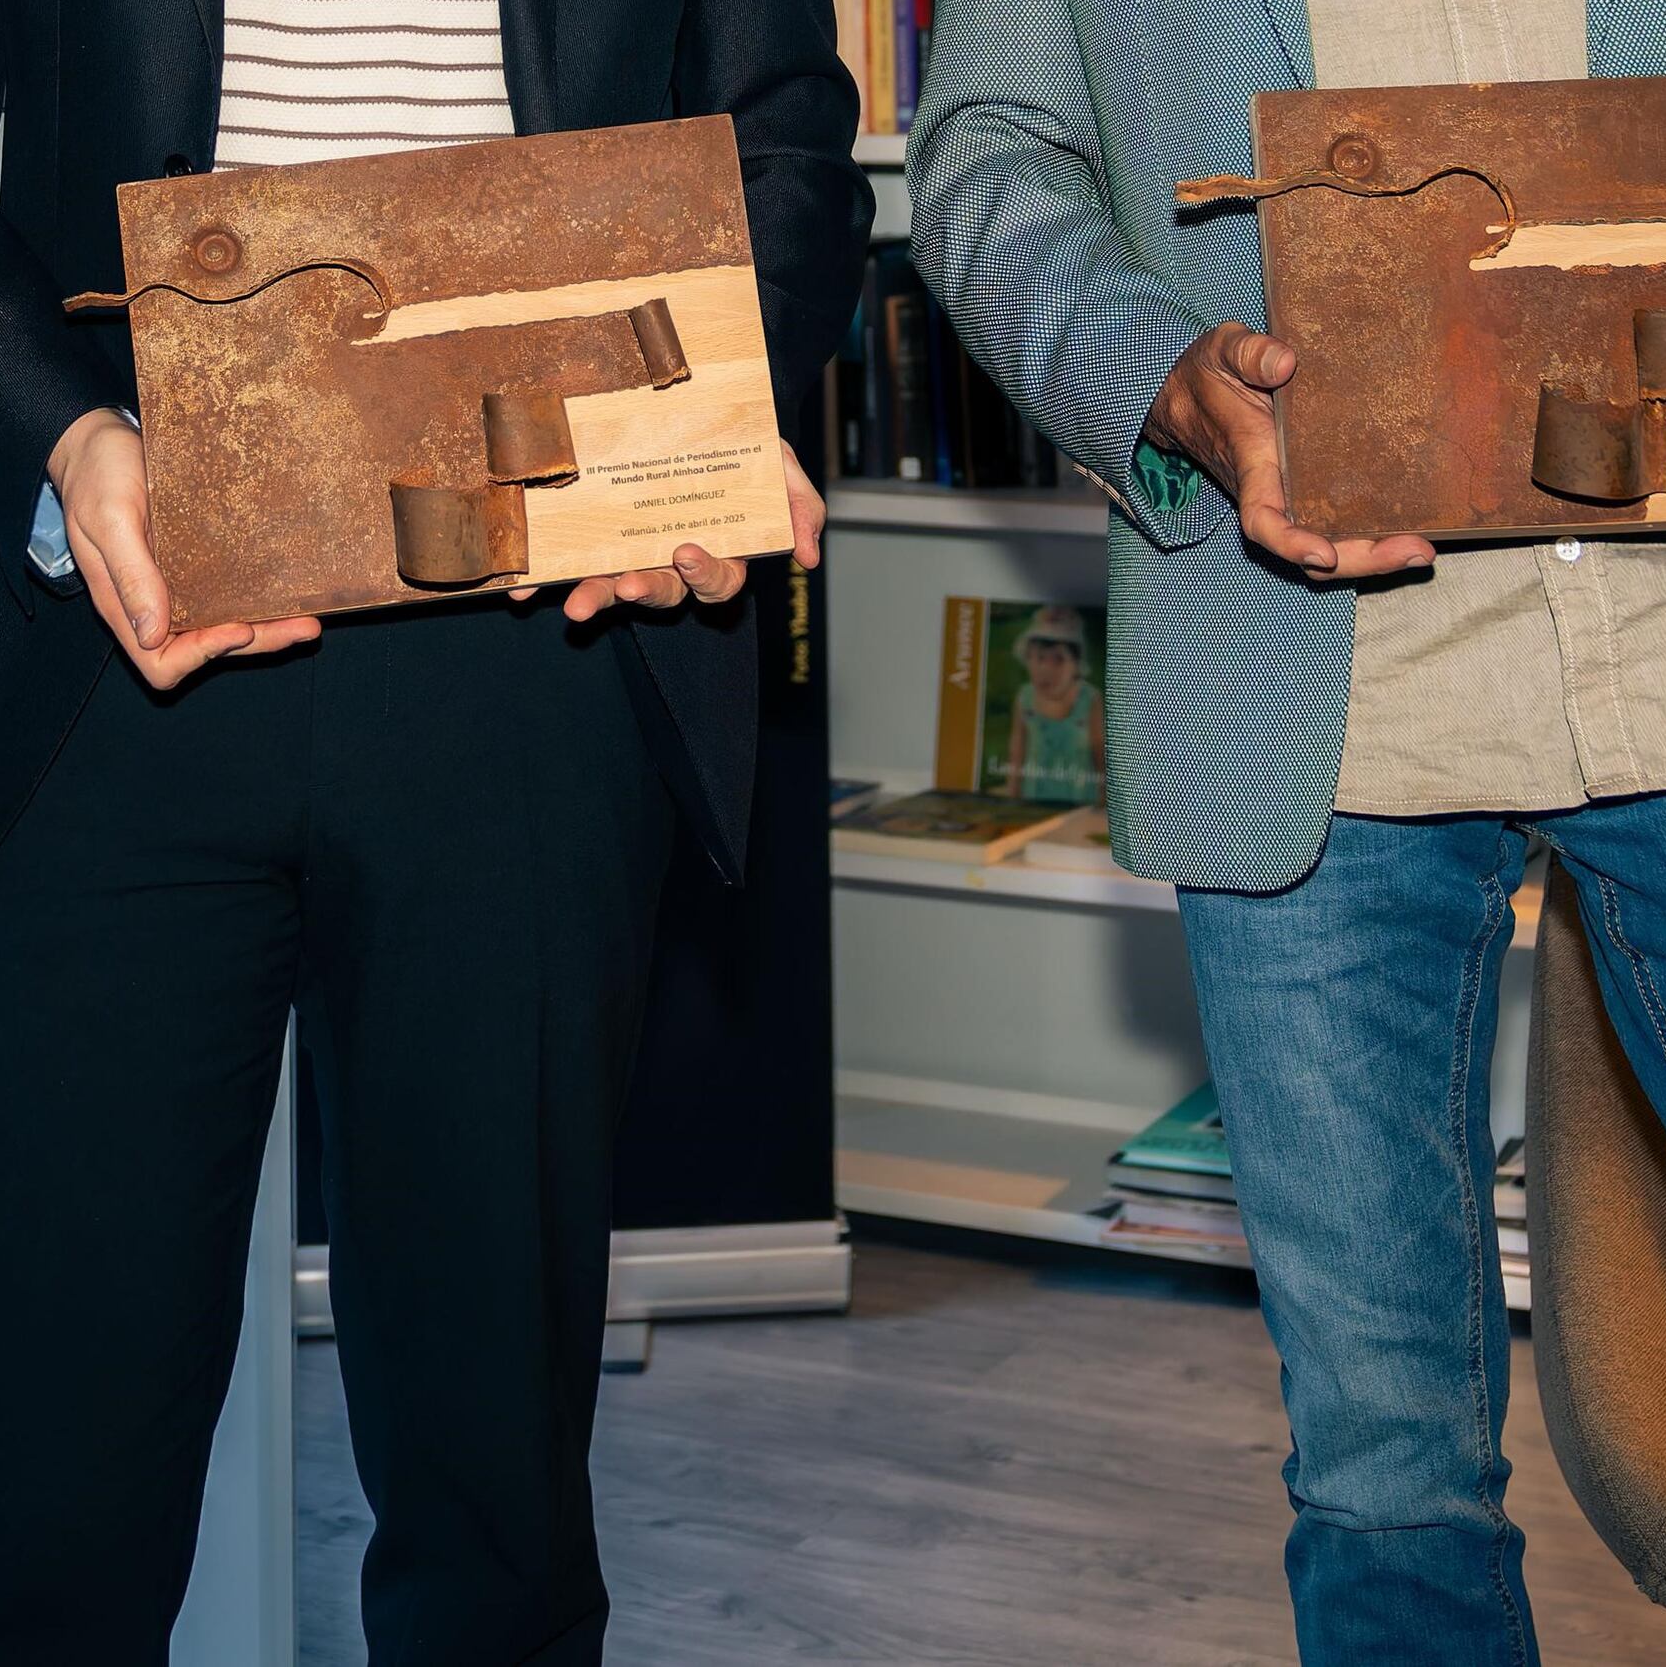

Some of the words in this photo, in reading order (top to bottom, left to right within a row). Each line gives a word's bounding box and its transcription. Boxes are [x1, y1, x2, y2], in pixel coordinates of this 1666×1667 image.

[587, 466, 595, 475] III
[597, 462, 630, 475] Premio
[632, 457, 671, 469] Nacional
[674, 454, 685, 464] de
[687, 448, 738, 462] Periodismo
[740, 447, 752, 455] en
[754, 445, 761, 454] el
[611, 473, 644, 485] Mundo
[646, 469, 671, 481] Rural
[673, 466, 704, 478] Ainhoa
[706, 461, 740, 473] Camino
[633, 497, 667, 510] DANIEL
[668, 489, 725, 505] DOMÍNGUEZ
[621, 524, 660, 538] Villanúa,
[662, 523, 673, 533] 26
[674, 521, 686, 531] de
[688, 517, 708, 529] abril
[710, 516, 721, 526] de
[723, 513, 745, 524] 2025
